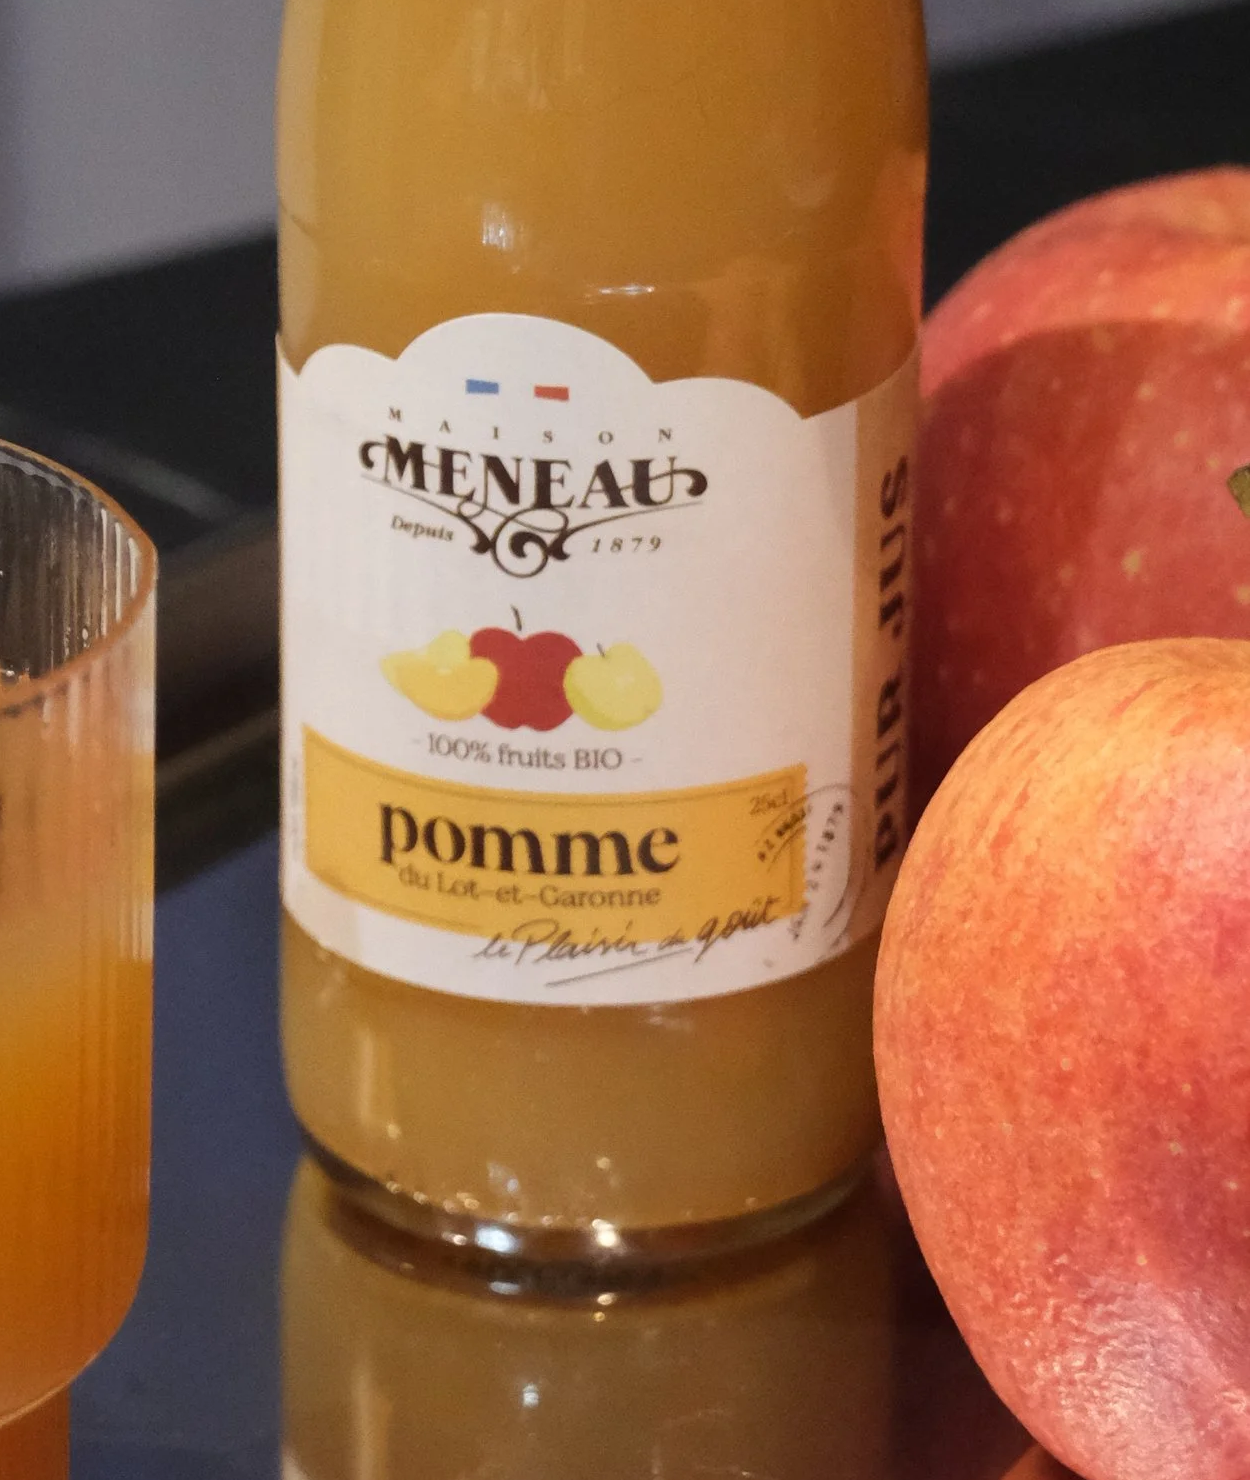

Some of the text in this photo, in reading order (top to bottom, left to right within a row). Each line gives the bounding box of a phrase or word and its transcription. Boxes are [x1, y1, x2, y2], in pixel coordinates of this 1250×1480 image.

[388, 406, 673, 445] MAISON
[358, 433, 708, 519] MENEAU
[390, 514, 454, 543] Depuis
[591, 535, 663, 555] 1879
[879, 455, 909, 639] JUS
[427, 732, 624, 770] 100% fruits BIO
[379, 802, 681, 876] pomme
[398, 866, 661, 909] du Lot-et-Garonne
